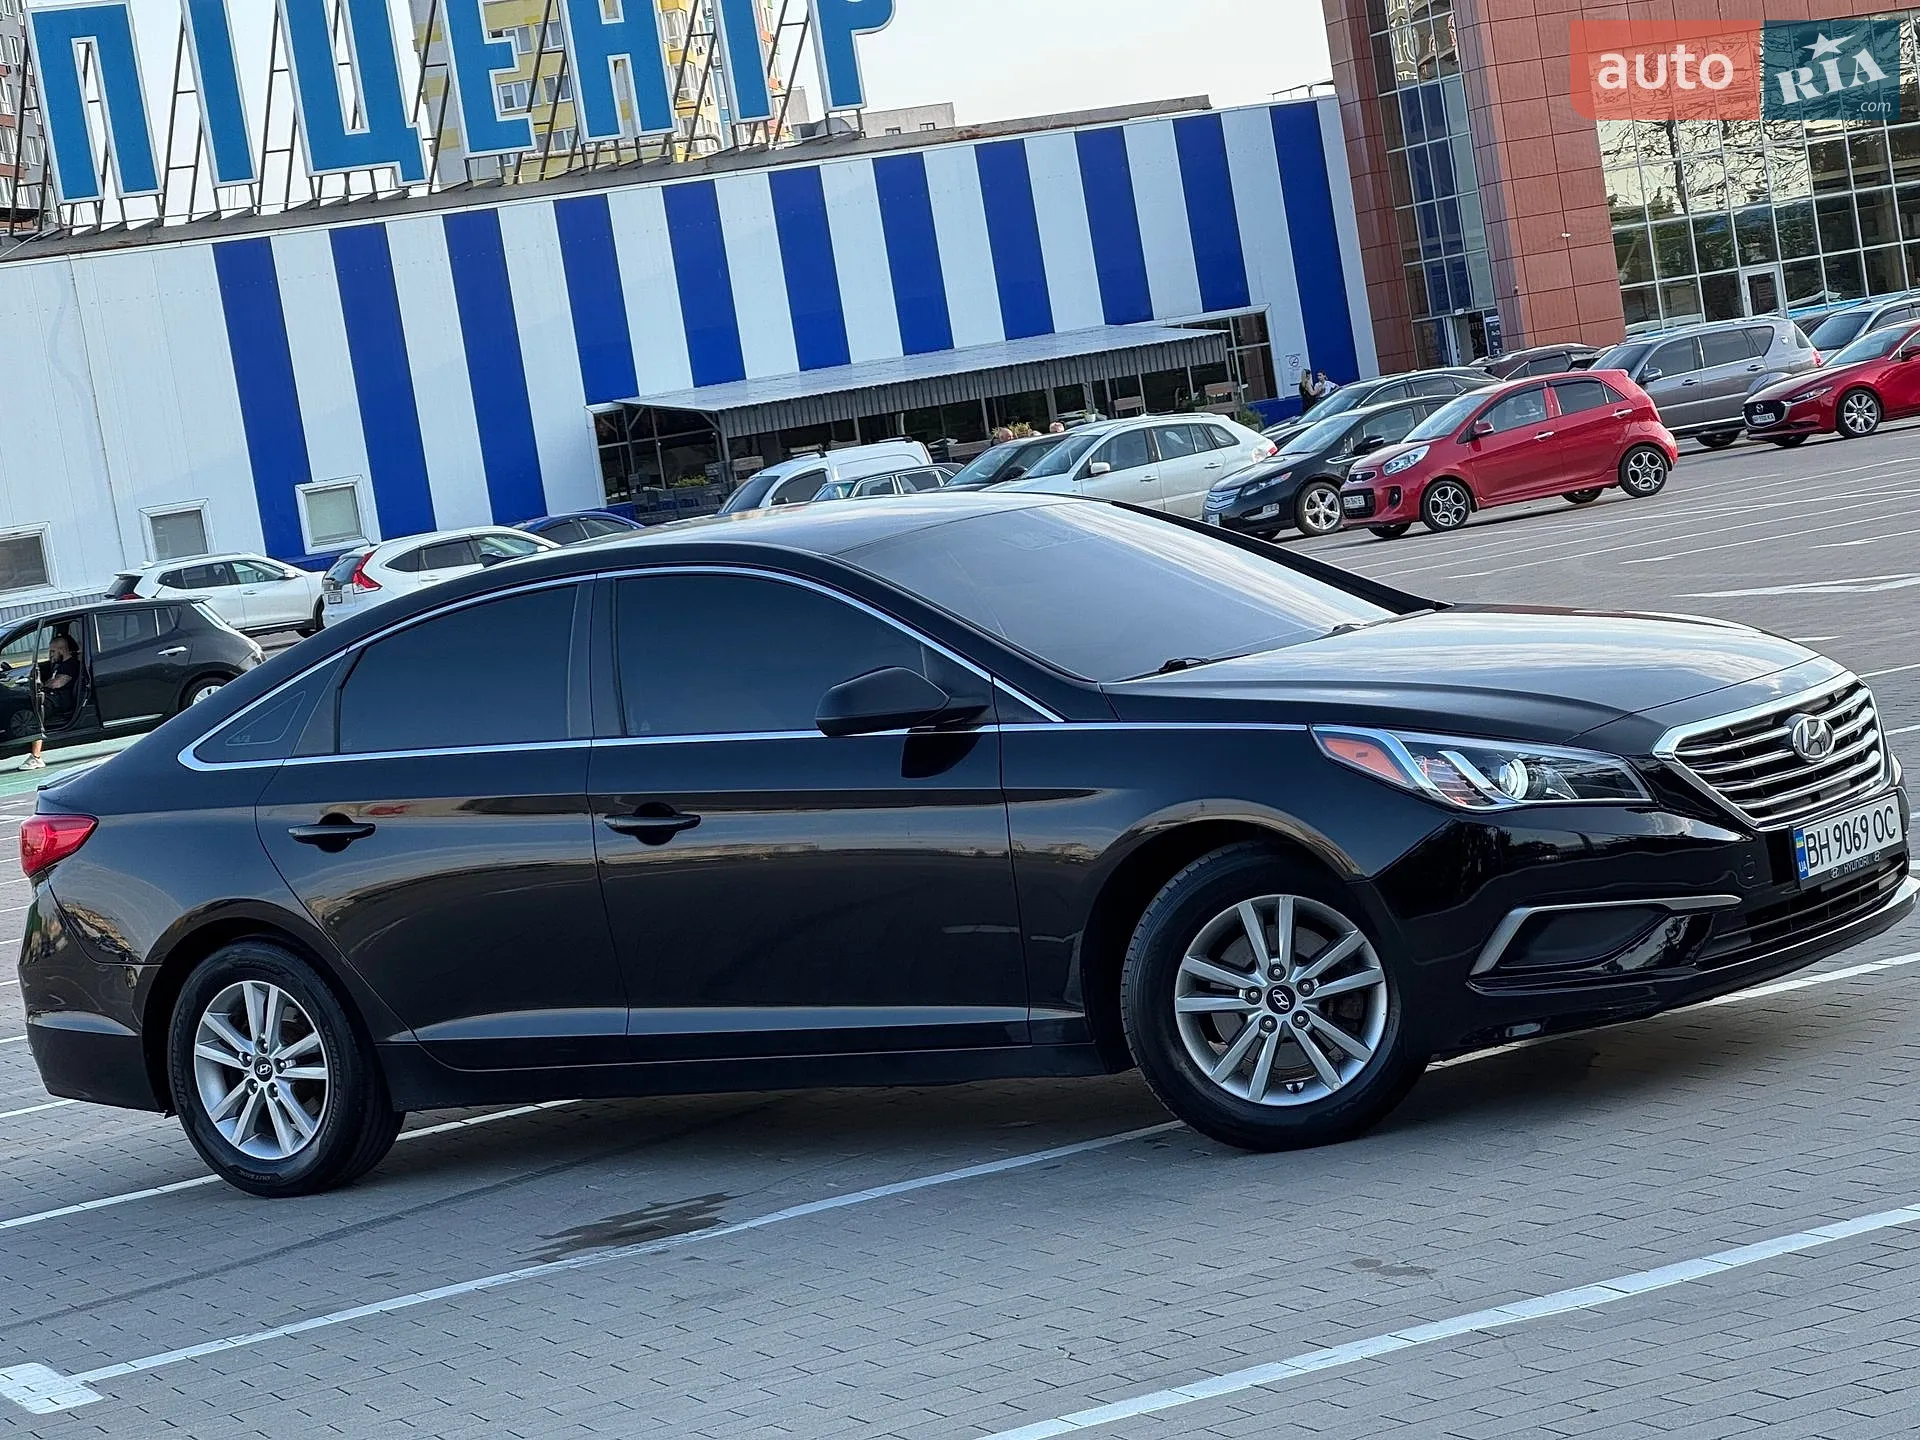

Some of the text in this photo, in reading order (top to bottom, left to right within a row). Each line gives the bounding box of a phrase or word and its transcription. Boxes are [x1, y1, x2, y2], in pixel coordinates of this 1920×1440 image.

[1805, 805, 1896, 869] BH 9069 OC
[1798, 861, 1809, 873] UA
[1843, 855, 1871, 874] HYUNDAI
